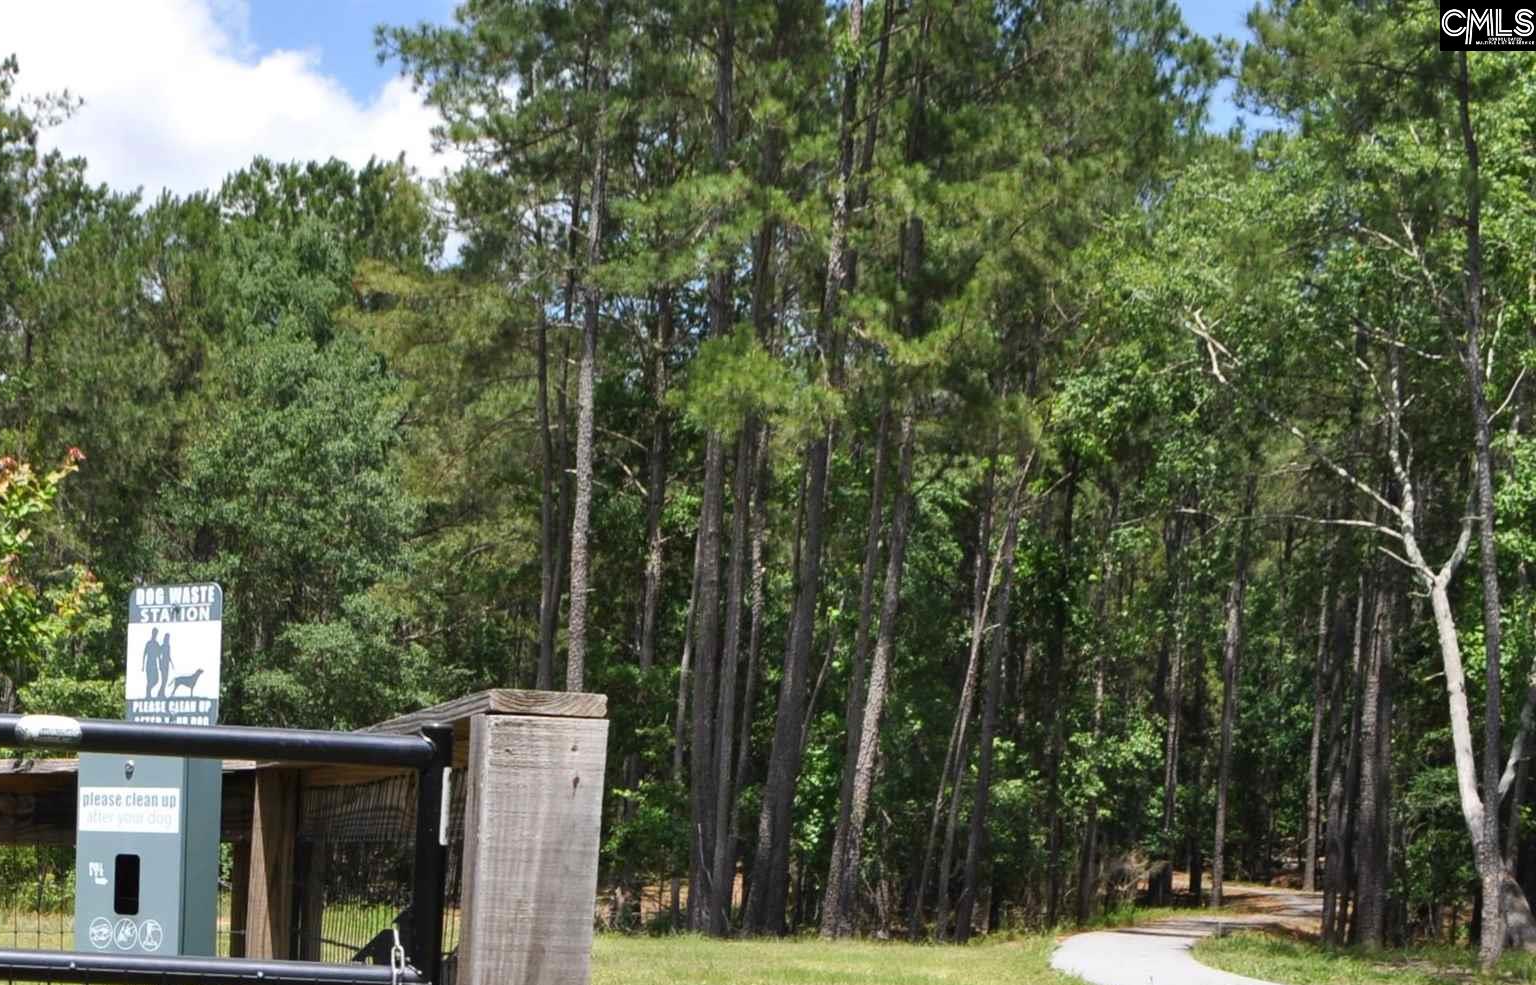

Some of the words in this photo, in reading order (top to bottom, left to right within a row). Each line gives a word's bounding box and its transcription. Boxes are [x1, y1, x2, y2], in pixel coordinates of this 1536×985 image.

[136, 587, 164, 605] DOG
[169, 585, 215, 604] WASTE
[133, 700, 166, 713] PLEASE
[168, 700, 197, 713] CLEAN
[199, 700, 212, 713] UP
[164, 716, 188, 725] YUR
[82, 792, 122, 808] please
[125, 792, 159, 808] clean
[161, 794, 177, 809] up
[147, 809, 173, 829] dog
